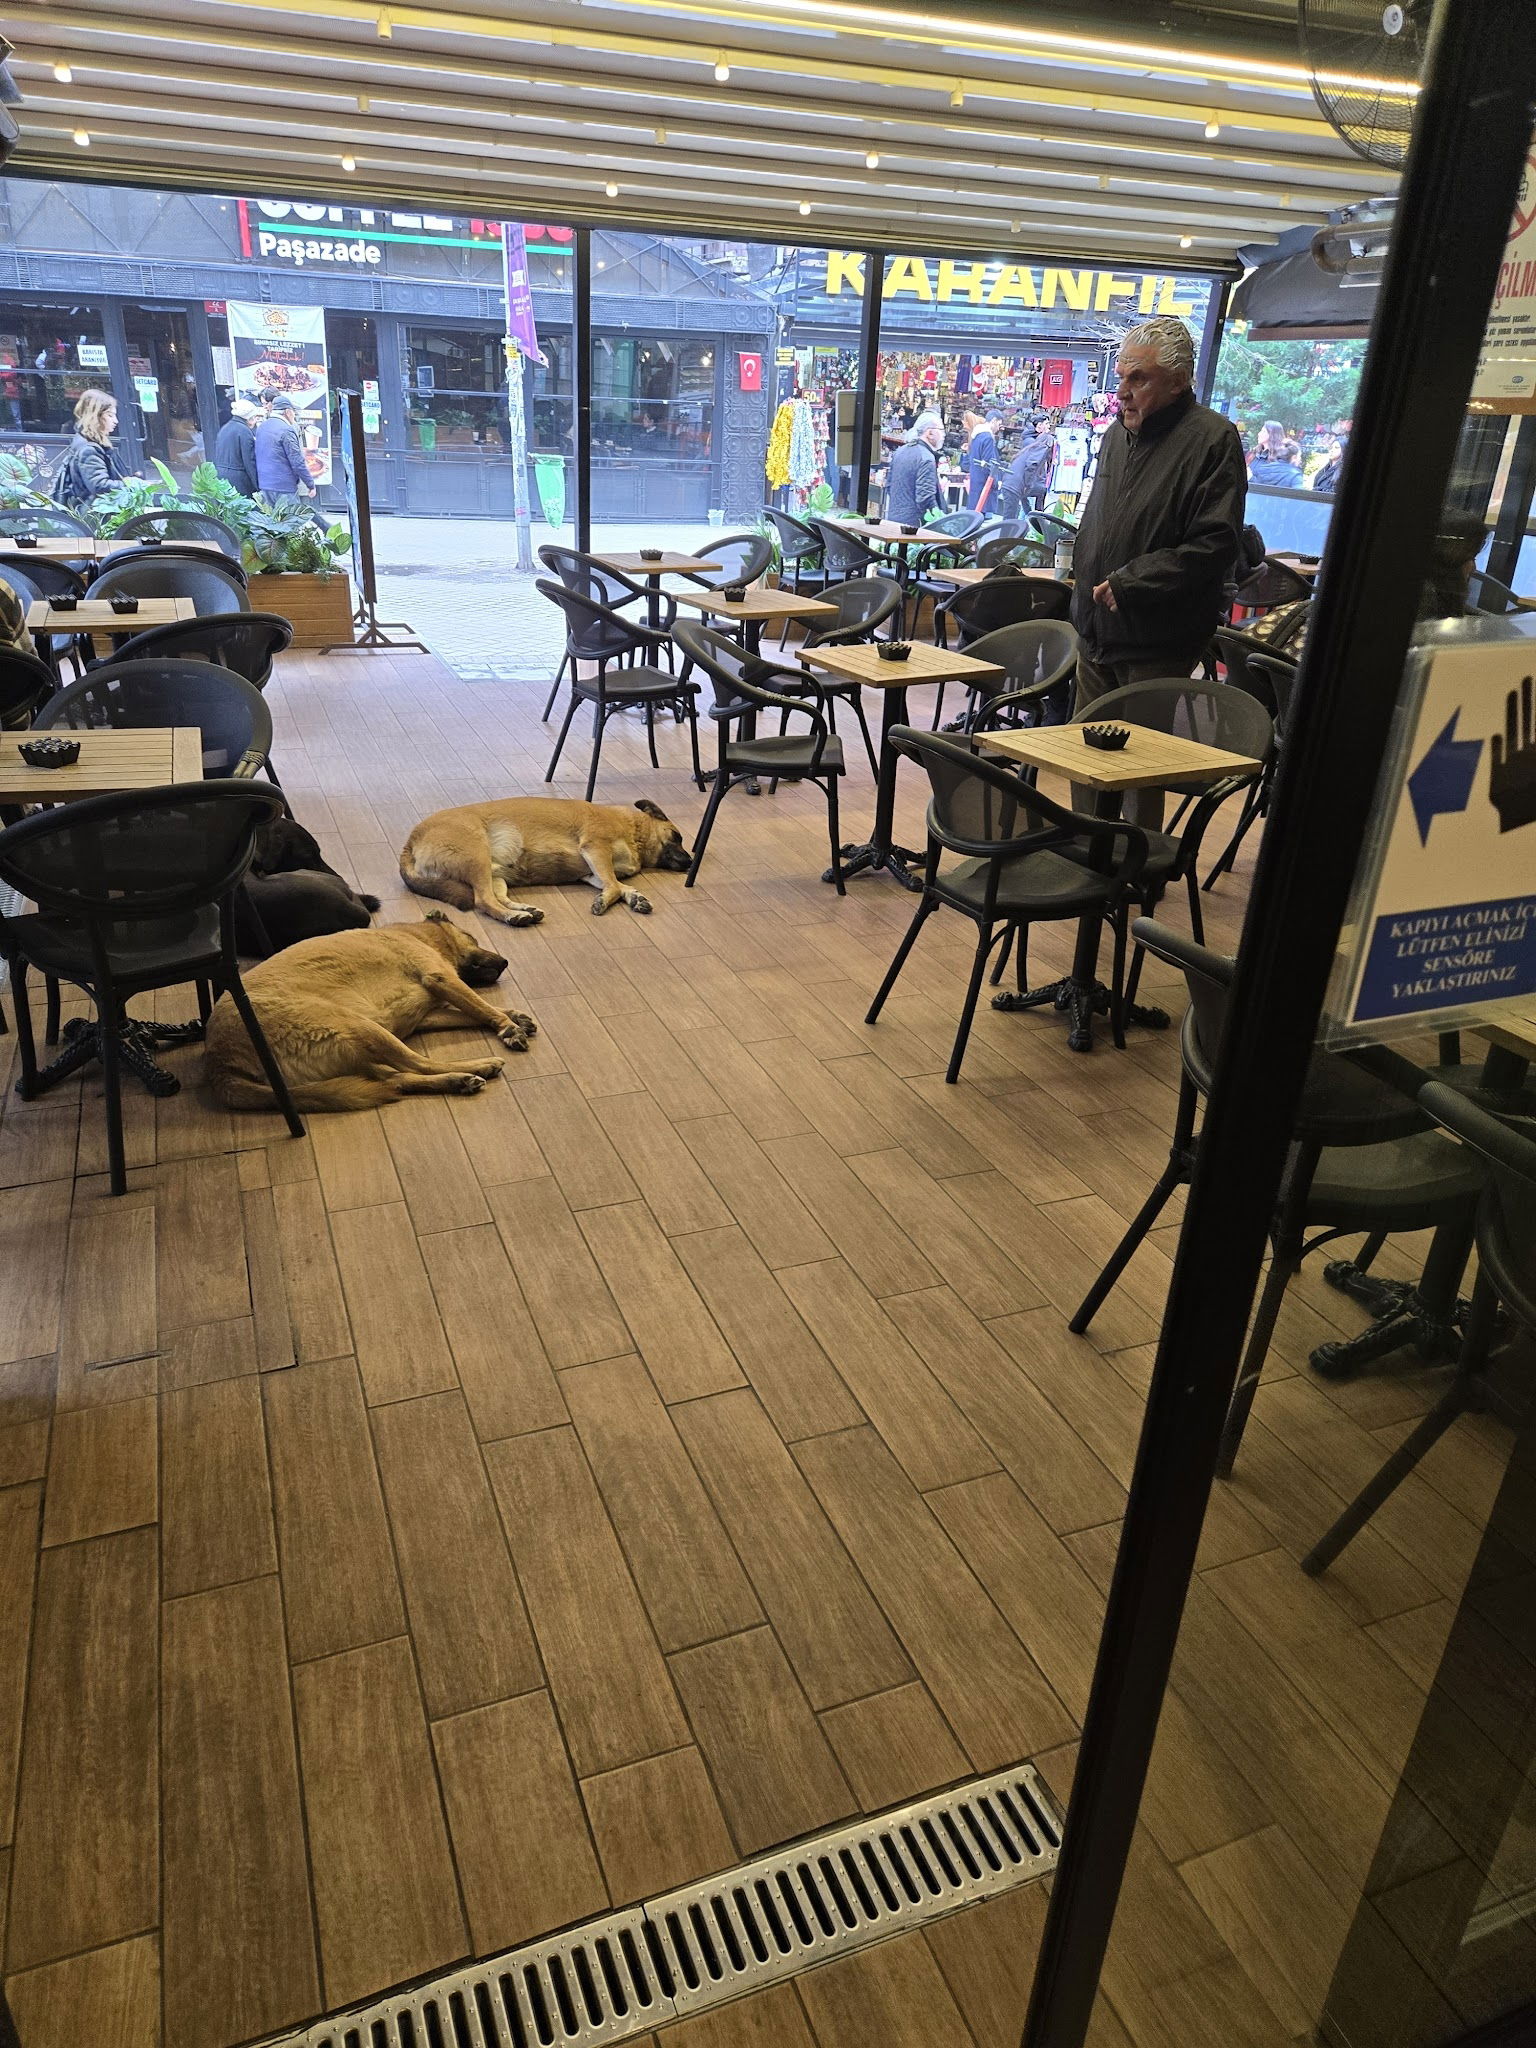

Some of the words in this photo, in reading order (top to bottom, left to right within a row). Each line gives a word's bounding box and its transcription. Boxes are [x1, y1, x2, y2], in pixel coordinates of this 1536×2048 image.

[258, 232, 382, 266] Paşazade
[1389, 915, 1450, 939] KAPIYI
[1452, 907, 1512, 931] AÇMAK
[1395, 933, 1462, 958] LÜTFEN
[1464, 921, 1528, 948] ELİNİZİ
[1422, 948, 1497, 974] SENSÖRE
[1391, 964, 1518, 999] YAKLAŞTIRINIZ
